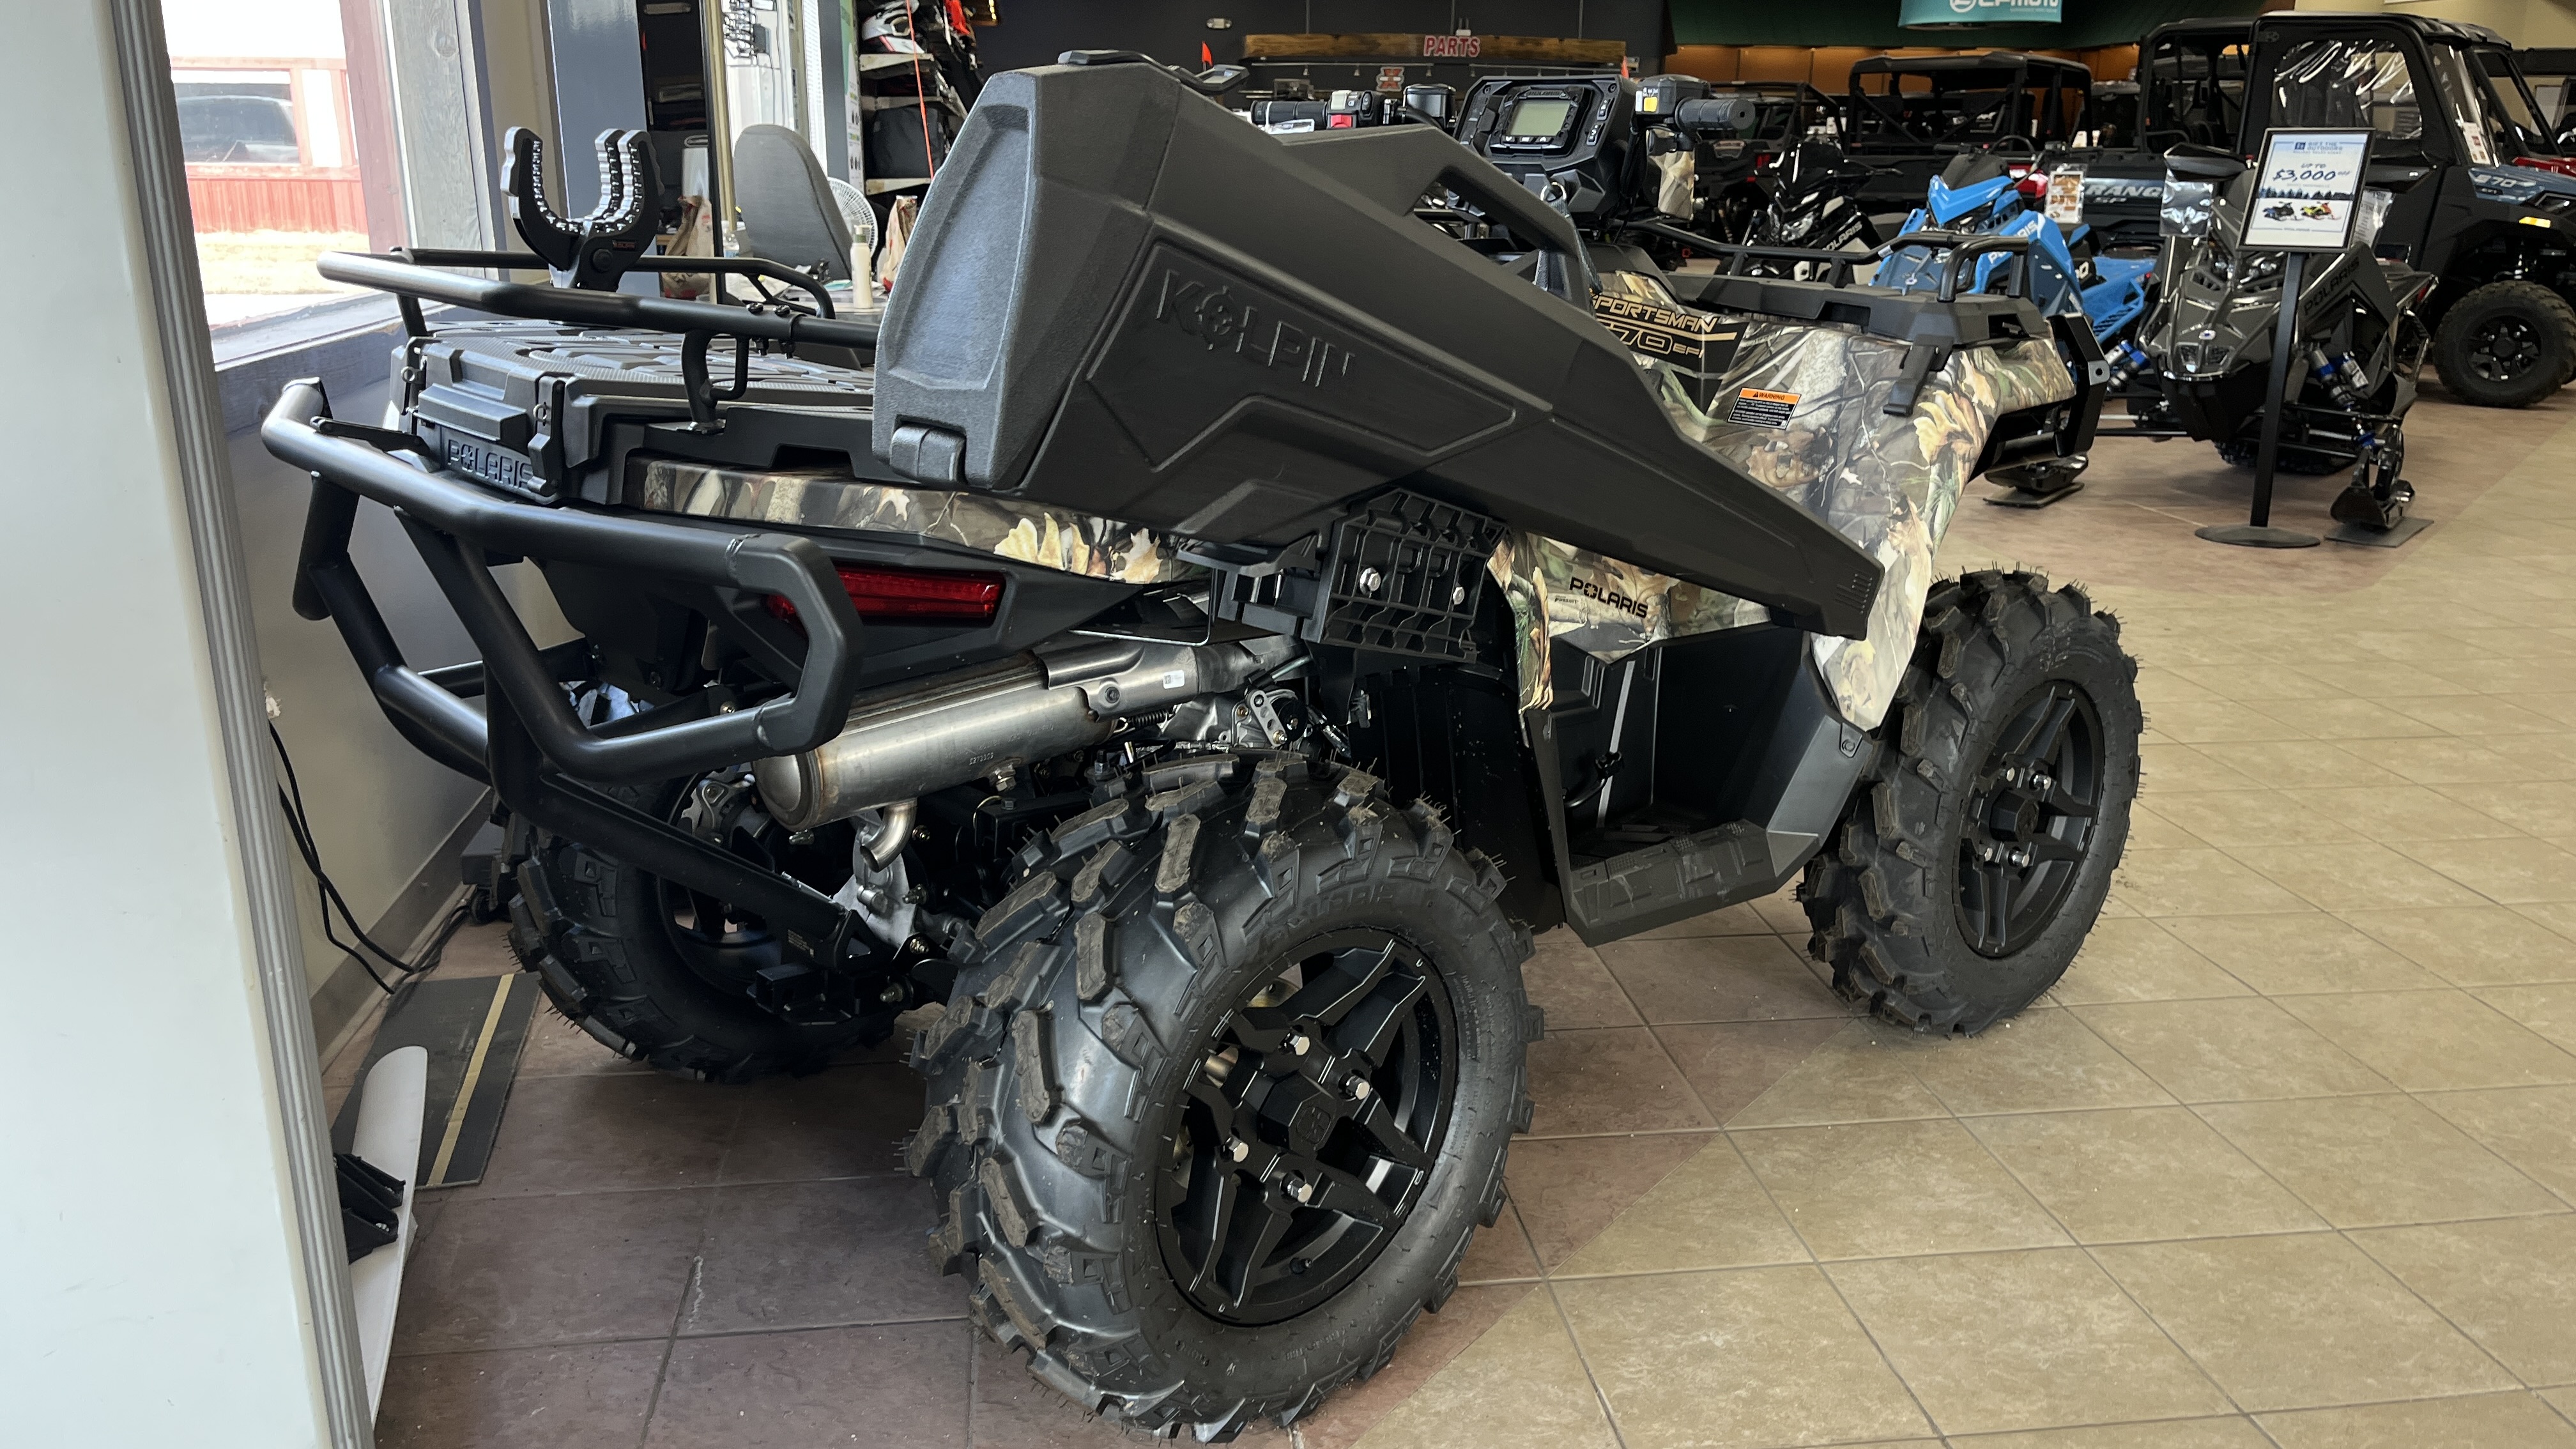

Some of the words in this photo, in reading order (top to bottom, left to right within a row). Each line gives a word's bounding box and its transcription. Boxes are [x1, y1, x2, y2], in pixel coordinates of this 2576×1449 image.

[1423, 35, 1480, 57] PARTS
[2273, 168, 2336, 182] $3,000
[2085, 184, 2165, 197] RANG
[1821, 221, 1862, 251] OLARIS
[2303, 256, 2360, 316] POLARIS
[1758, 392, 1786, 401] WARNING
[447, 439, 537, 494] POLARIS
[1569, 576, 1648, 618] POLARIS
